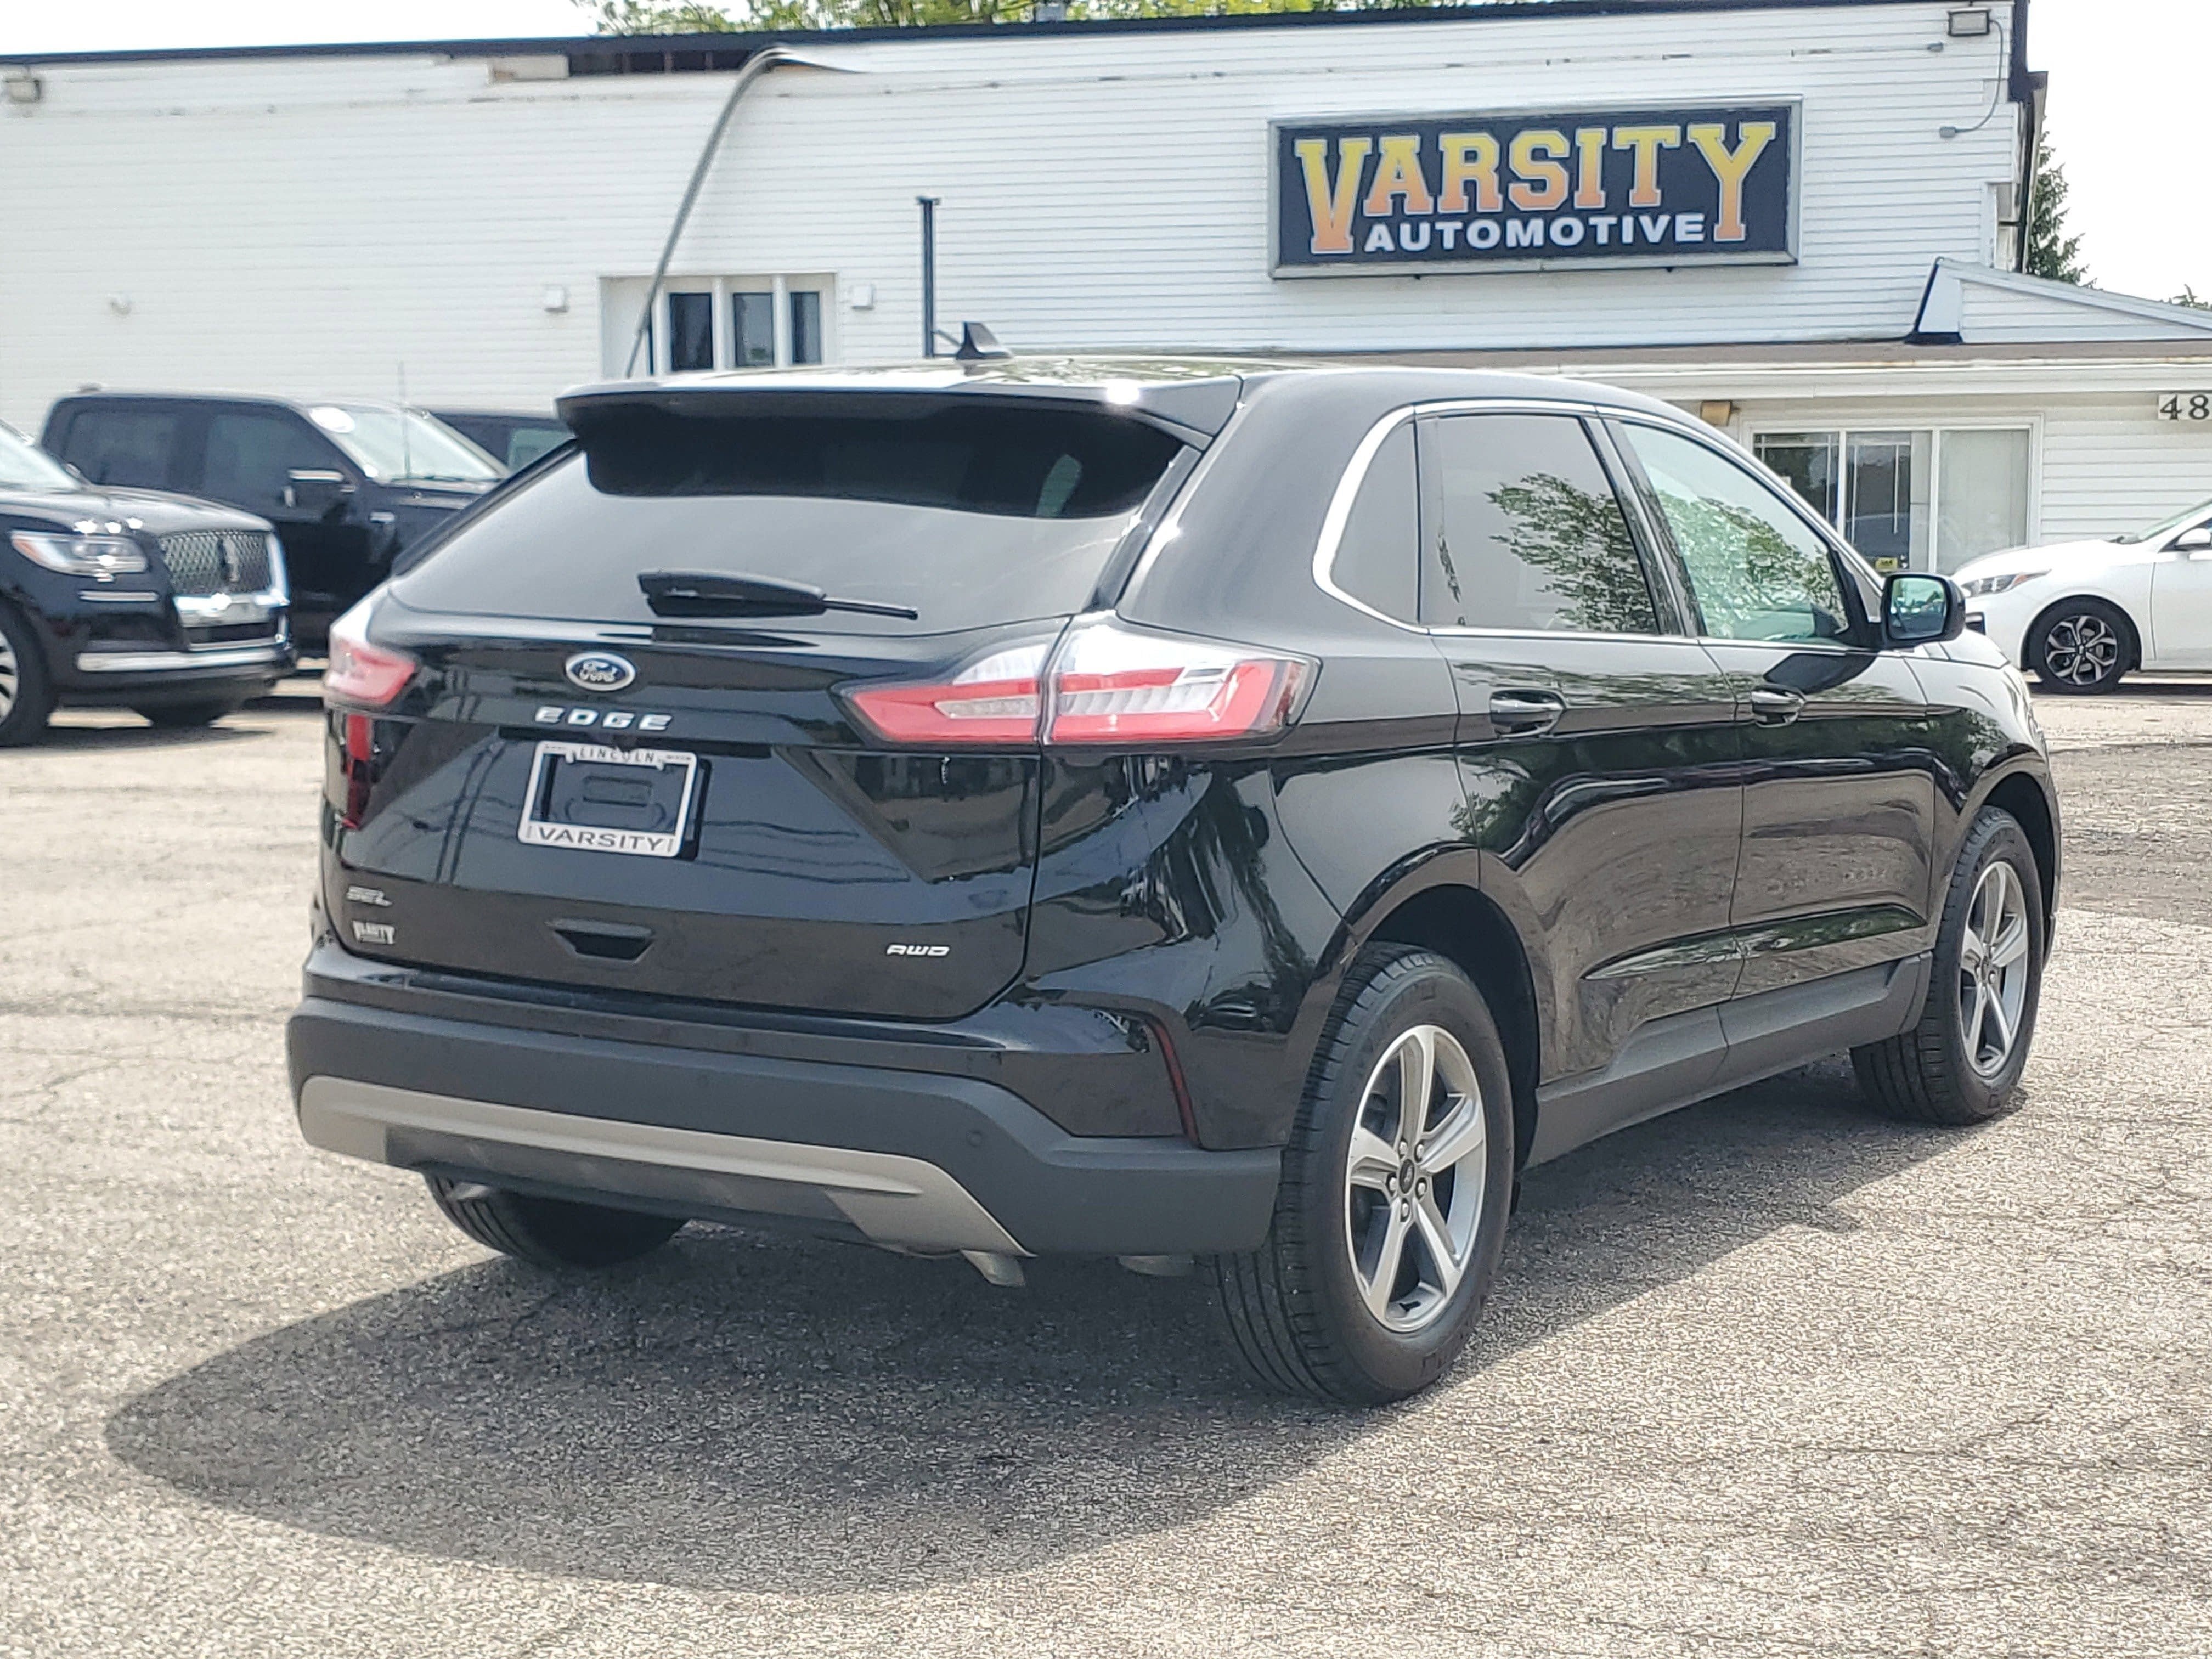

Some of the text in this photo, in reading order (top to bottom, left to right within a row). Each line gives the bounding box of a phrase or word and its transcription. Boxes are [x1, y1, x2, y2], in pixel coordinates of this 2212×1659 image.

[1295, 122, 1775, 255] VARSITY
[1363, 213, 1705, 252] AUTOMOTIVE
[2160, 394, 2210, 421] 48
[579, 661, 618, 682] Ford
[535, 706, 673, 730] EDGE
[579, 747, 654, 763] LINCOLN
[539, 827, 663, 851] VARSITY
[887, 944, 950, 956] AWD
